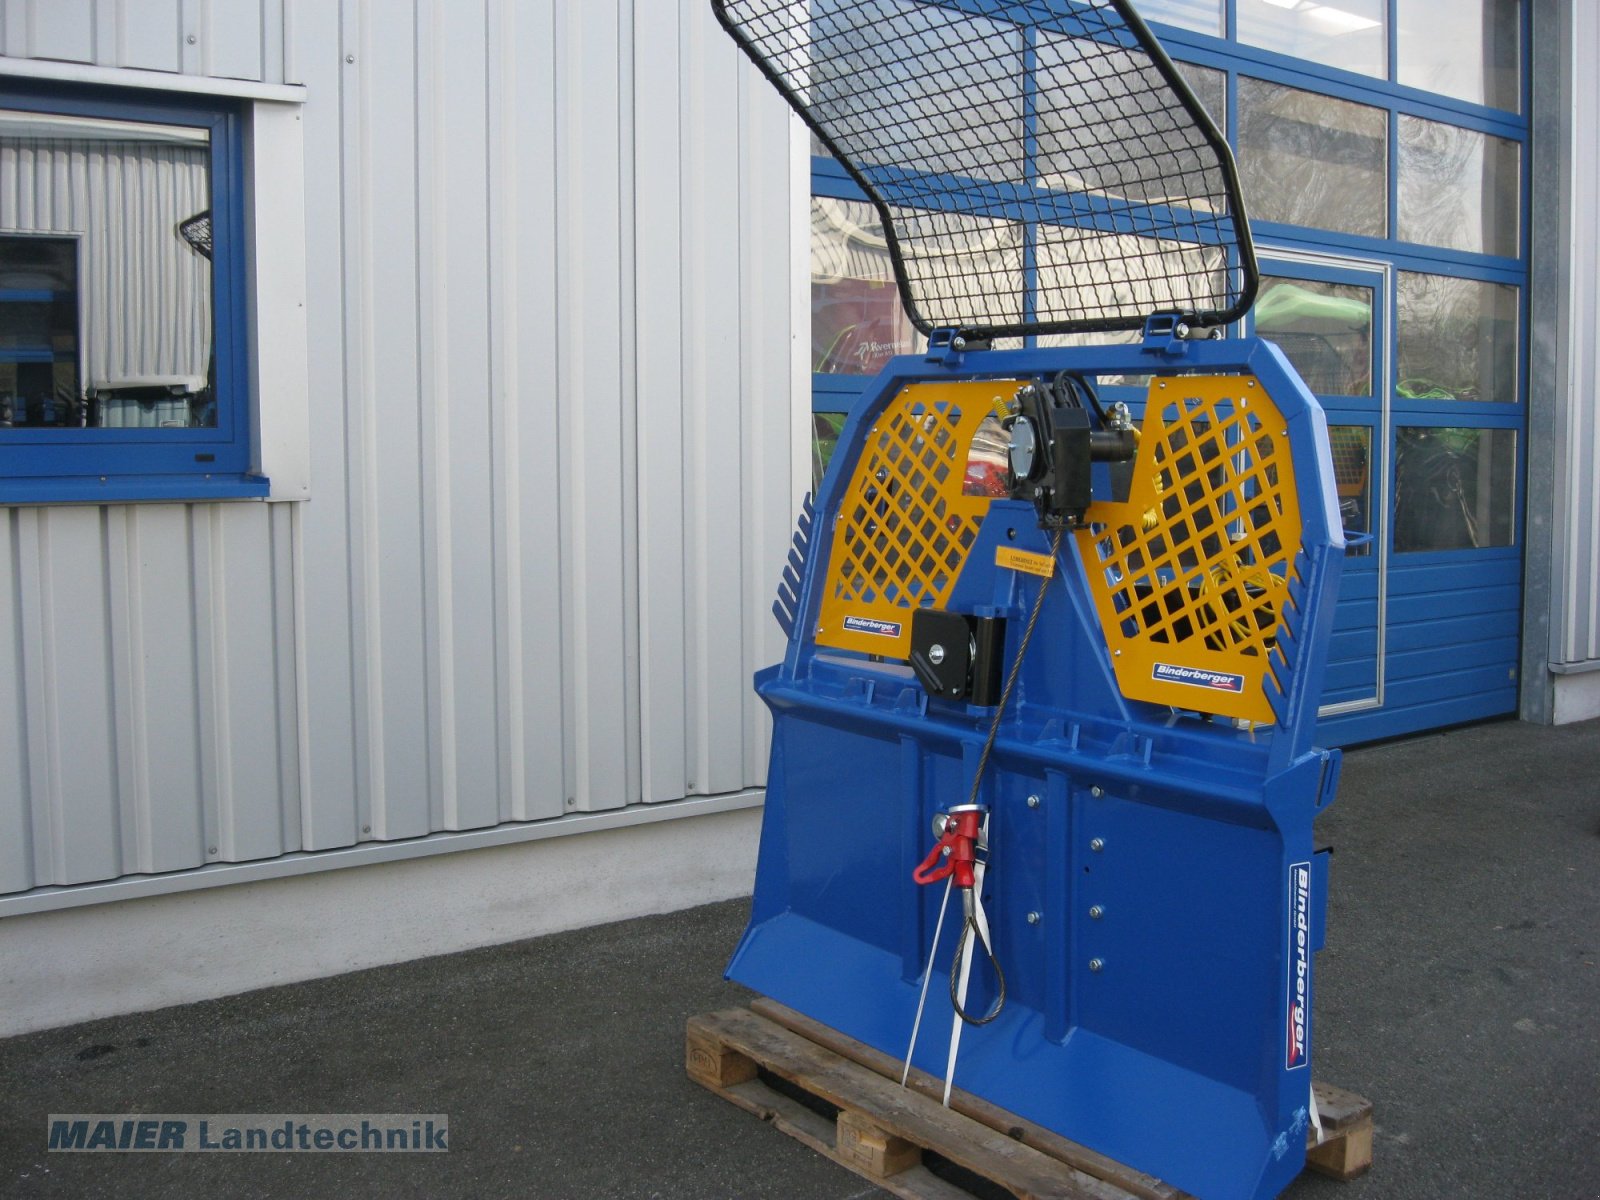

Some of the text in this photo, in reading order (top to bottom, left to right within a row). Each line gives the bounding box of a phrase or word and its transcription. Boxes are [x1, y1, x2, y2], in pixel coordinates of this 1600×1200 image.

[846, 617, 896, 631] Binderberger
[1156, 665, 1235, 684] Binderberger
[1294, 867, 1308, 1056] Binderberger
